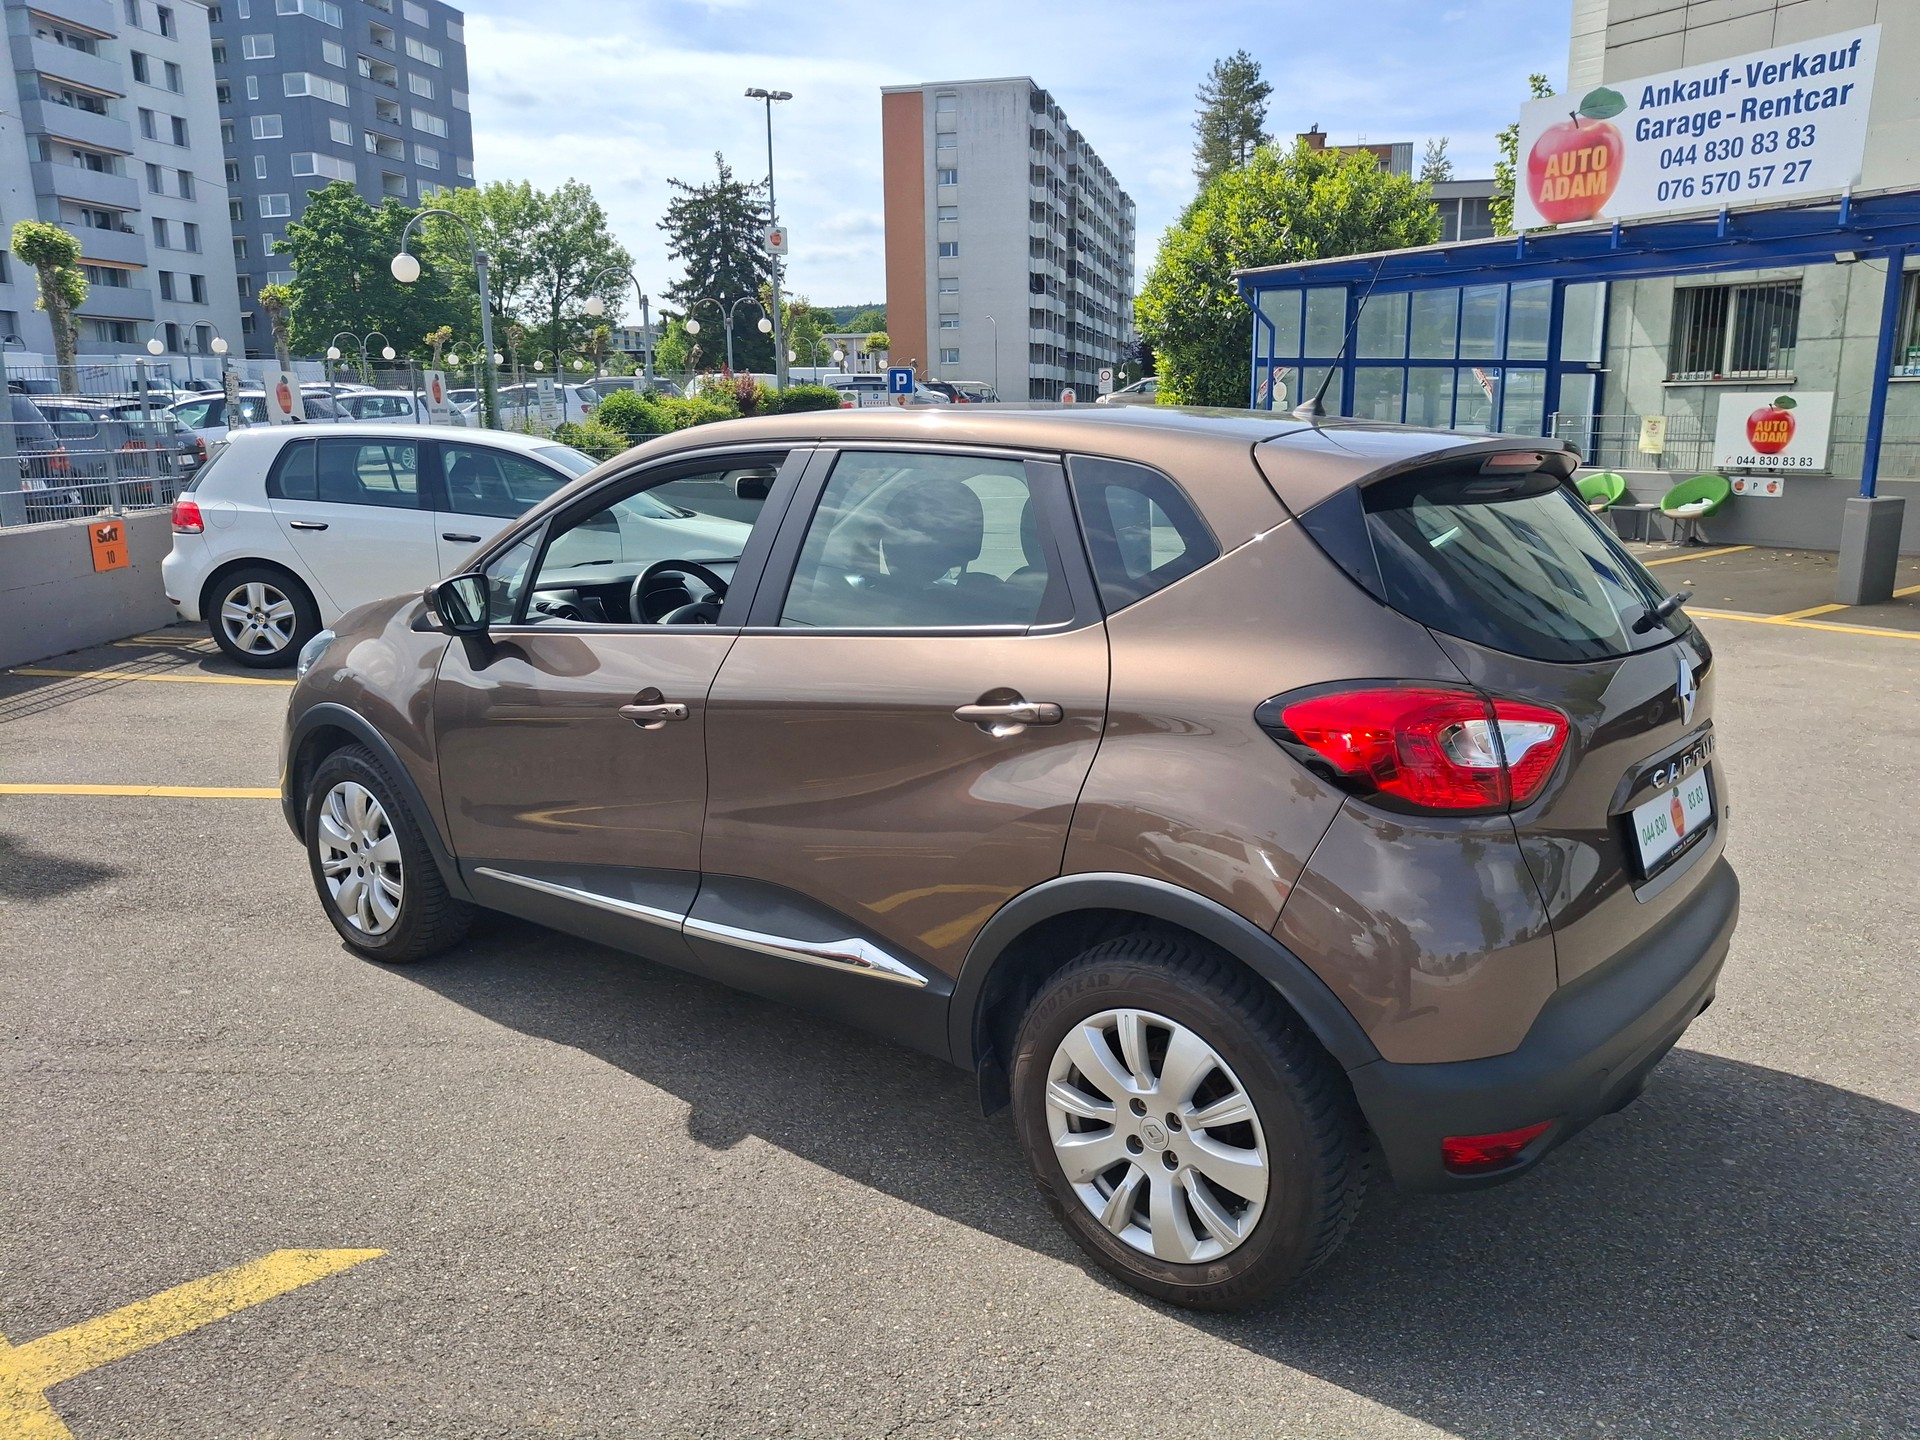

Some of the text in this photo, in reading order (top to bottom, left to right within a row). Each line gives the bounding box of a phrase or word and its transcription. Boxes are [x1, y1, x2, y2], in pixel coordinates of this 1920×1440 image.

[1660, 124, 1816, 169] 044 830 83 83
[1544, 145, 1608, 179] AUTO
[1539, 170, 1608, 203] ADAM
[1657, 159, 1813, 201] 076 570 57 27
[896, 373, 907, 391] P
[1755, 420, 1788, 432] AUTO
[1751, 431, 1788, 443] ADAM
[1737, 456, 1813, 467] 044 830 83 83
[1752, 482, 1758, 490] P
[106, 550, 116, 564] 10
[1687, 785, 1704, 810] 83 83
[1642, 823, 1655, 846] 044
[1655, 813, 1667, 834] 830
